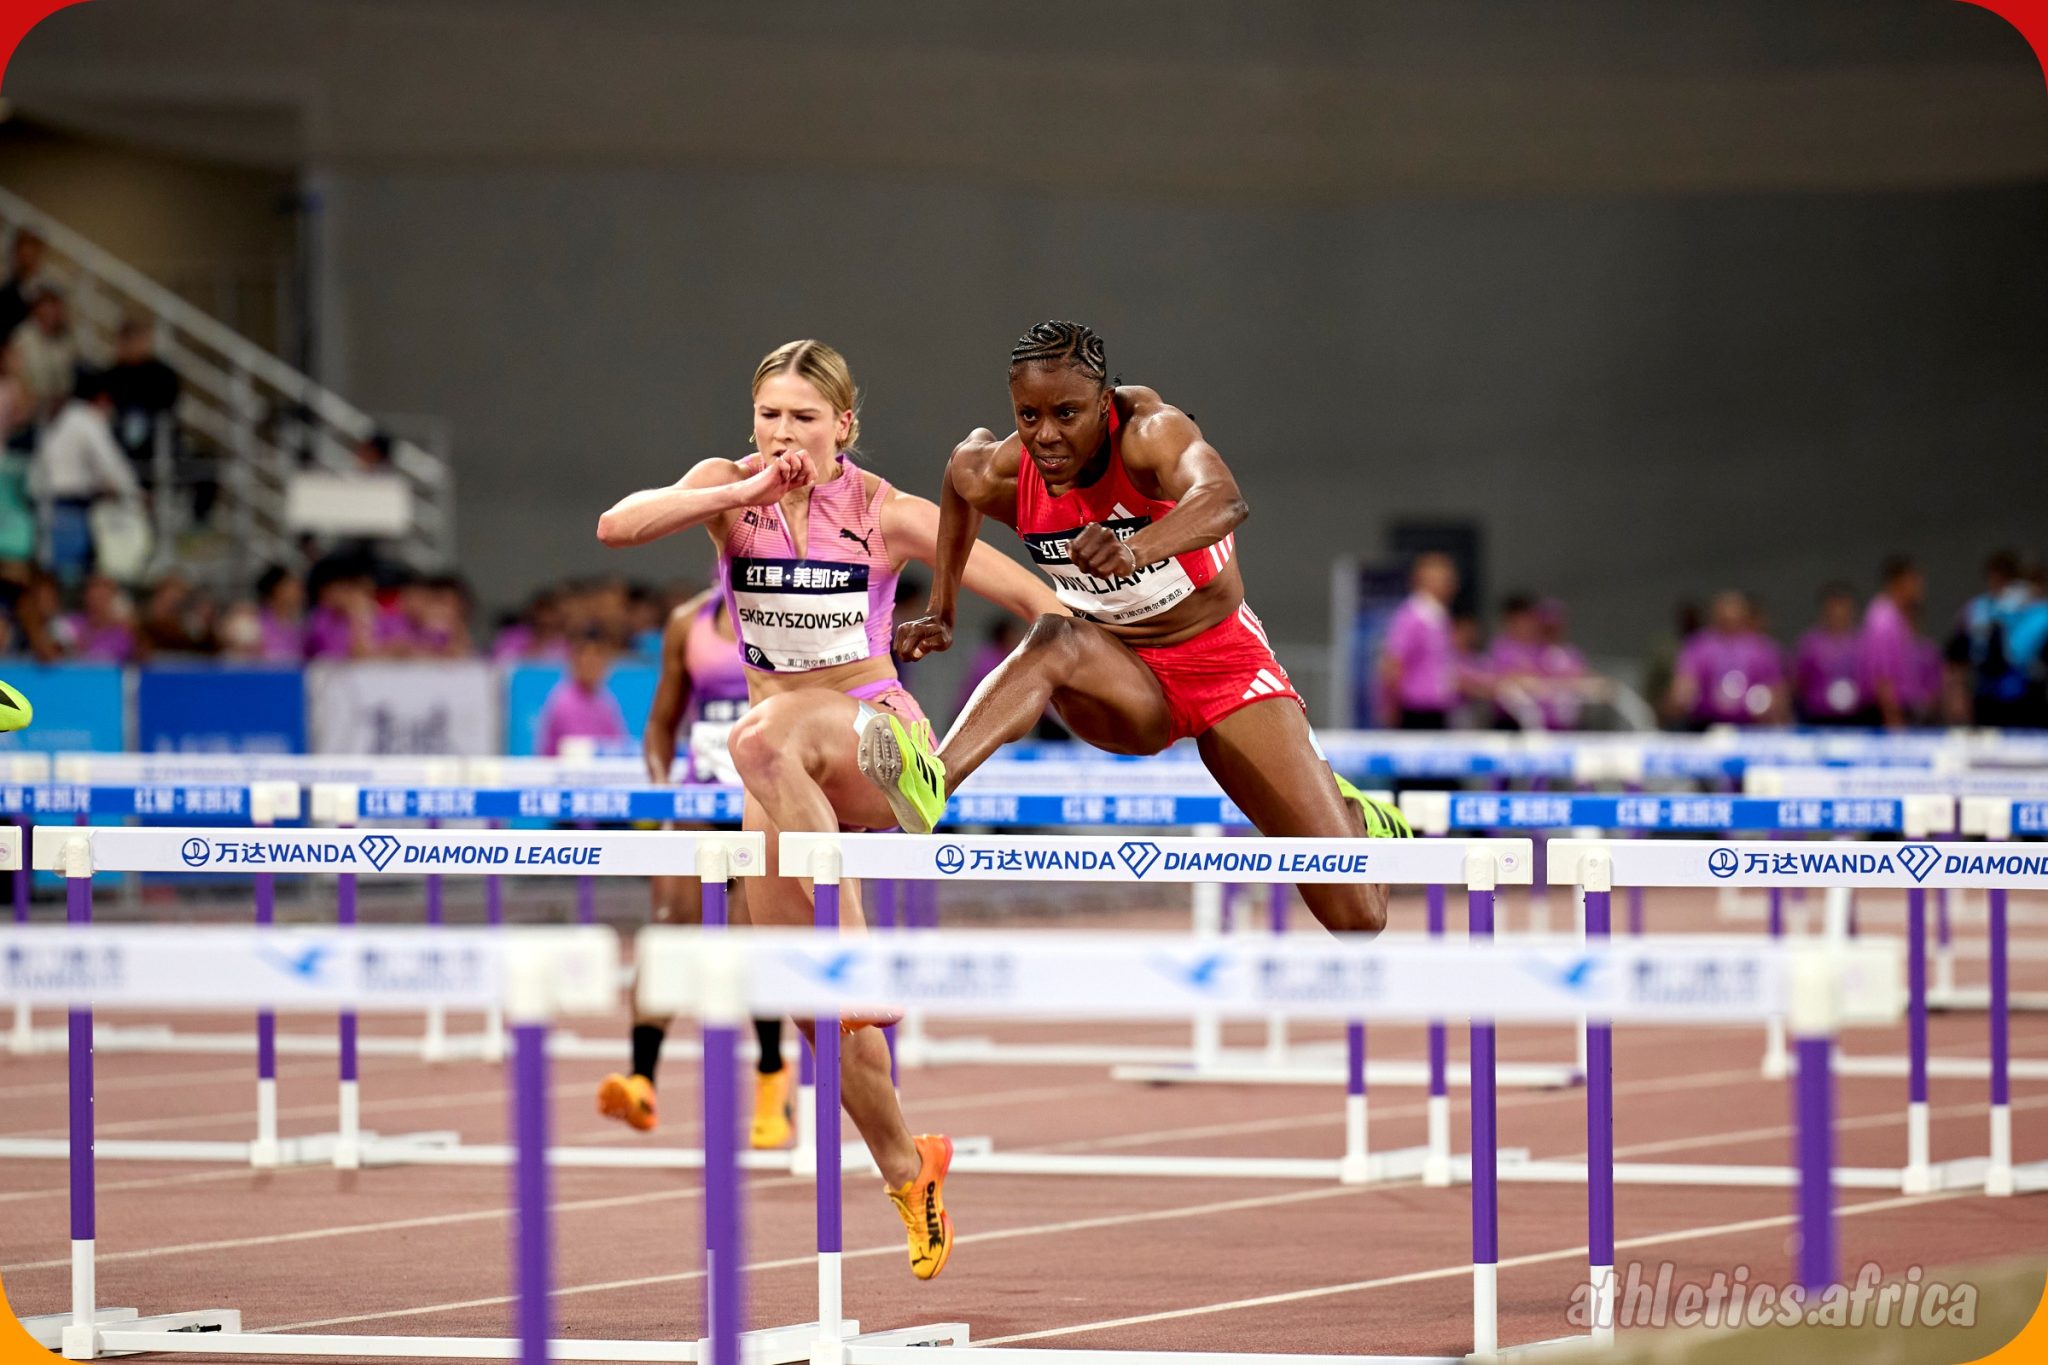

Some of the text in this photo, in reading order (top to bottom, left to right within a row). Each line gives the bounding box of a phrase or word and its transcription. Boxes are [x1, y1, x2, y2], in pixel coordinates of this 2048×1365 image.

[746, 565, 850, 589] 红星·美凯龙
[739, 608, 865, 630] SKRZYSZOWSKA
[404, 845, 509, 864] DIAMOND
[514, 846, 602, 865] LEAGUE
[1164, 852, 1272, 872] DIAMOND
[1278, 853, 1369, 873] LEAGUE
